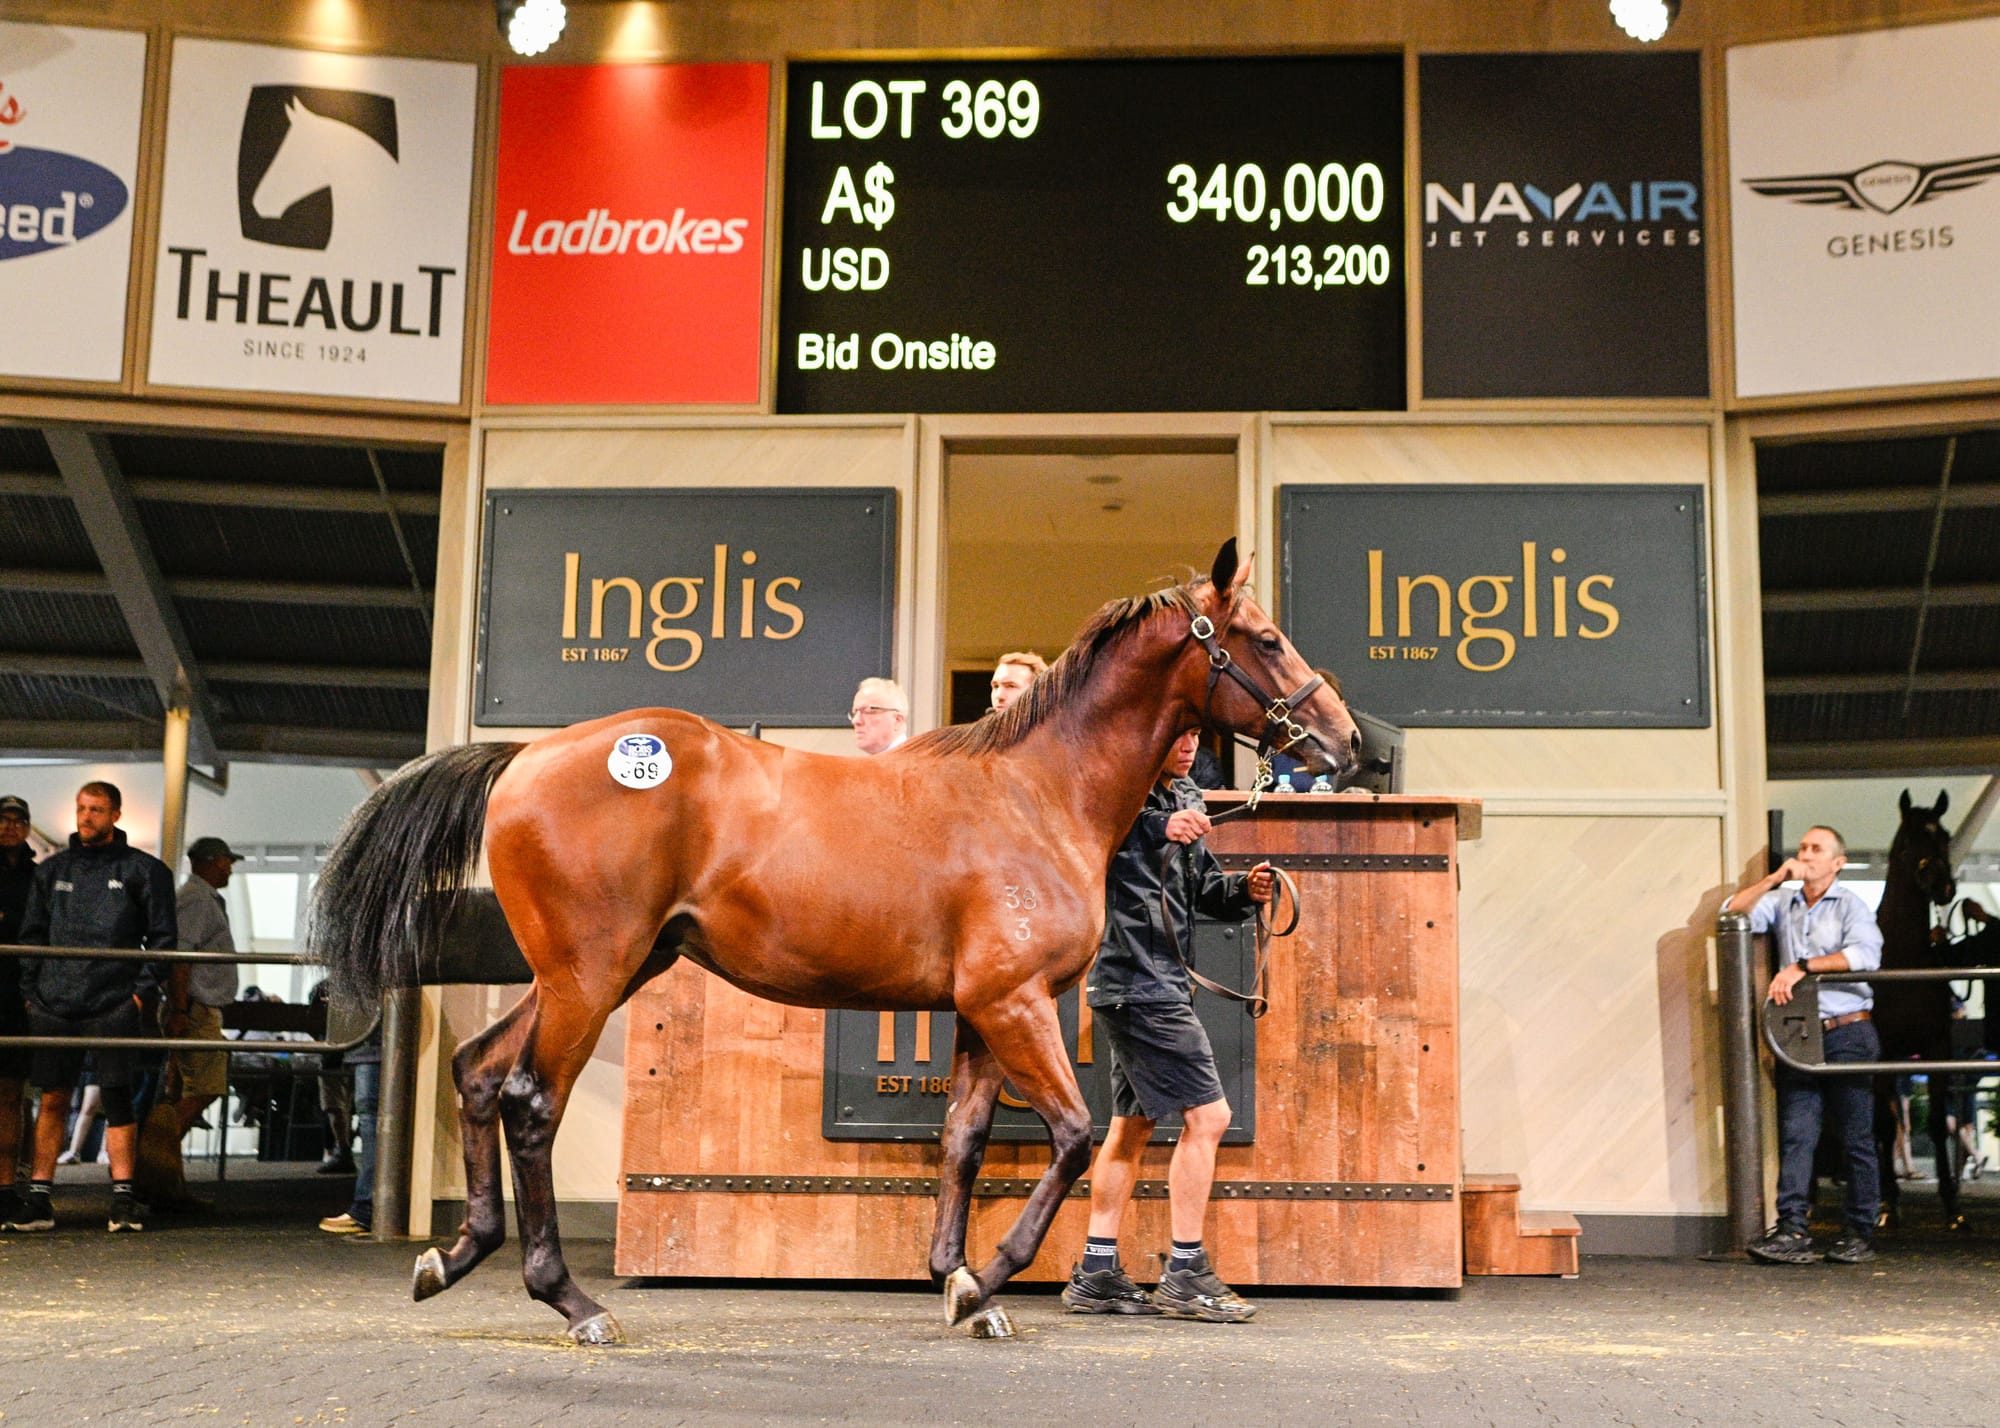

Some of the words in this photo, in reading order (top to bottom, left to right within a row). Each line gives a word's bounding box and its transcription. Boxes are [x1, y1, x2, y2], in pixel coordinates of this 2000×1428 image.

[811, 80, 927, 139] LOT
[941, 79, 1040, 139] 369
[820, 161, 895, 231] A$
[1166, 162, 1384, 231] 340,000
[1425, 181, 1698, 224] NAVAIR
[508, 207, 749, 255] Ladbrokes
[1426, 230, 1487, 248] JET
[1516, 229, 1701, 248] SERVICES
[1827, 225, 1955, 259] GENESIS
[802, 247, 890, 292] USD
[1246, 245, 1390, 291] 213,200
[168, 246, 457, 337] THEAULT
[243, 339, 305, 360] SINCE
[319, 345, 367, 364] 1924
[798, 332, 860, 370] Bid
[871, 332, 997, 370] Onsite
[562, 544, 805, 671] Inglis
[1368, 541, 1620, 672] Inglis
[562, 648, 588, 662] EST
[594, 648, 629, 662] 1867
[1369, 646, 1396, 660] EST
[1402, 647, 1438, 660] 1867
[1014, 917, 1032, 941] 3
[877, 1075, 912, 1093] EST
[918, 1076, 953, 1094] 186
